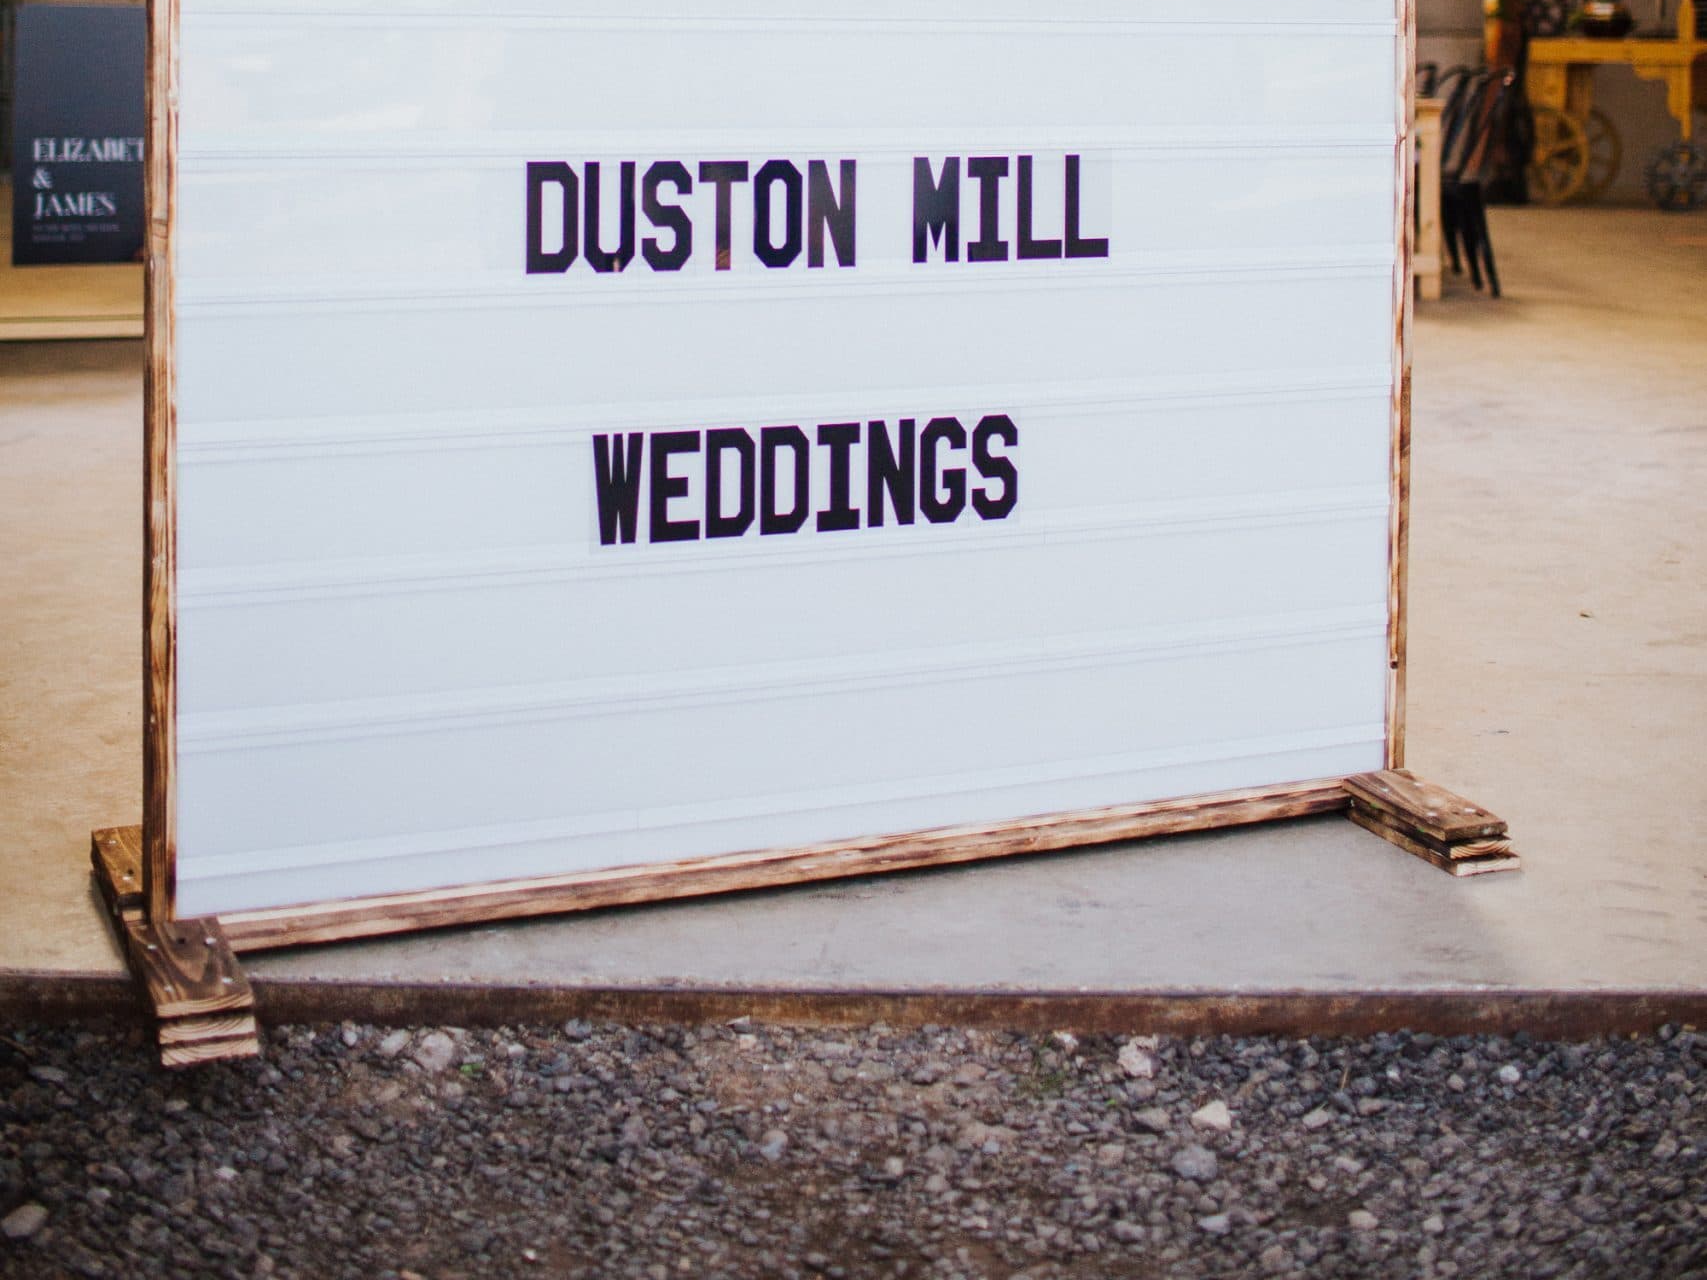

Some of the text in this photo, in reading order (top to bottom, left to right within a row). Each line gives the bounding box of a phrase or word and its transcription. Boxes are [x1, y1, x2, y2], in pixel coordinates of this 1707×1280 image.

[33, 166, 53, 189] &
[33, 192, 117, 220] JAMES
[526, 154, 1109, 274] DUSTON MILL
[592, 414, 1018, 546] WEDDINGS
